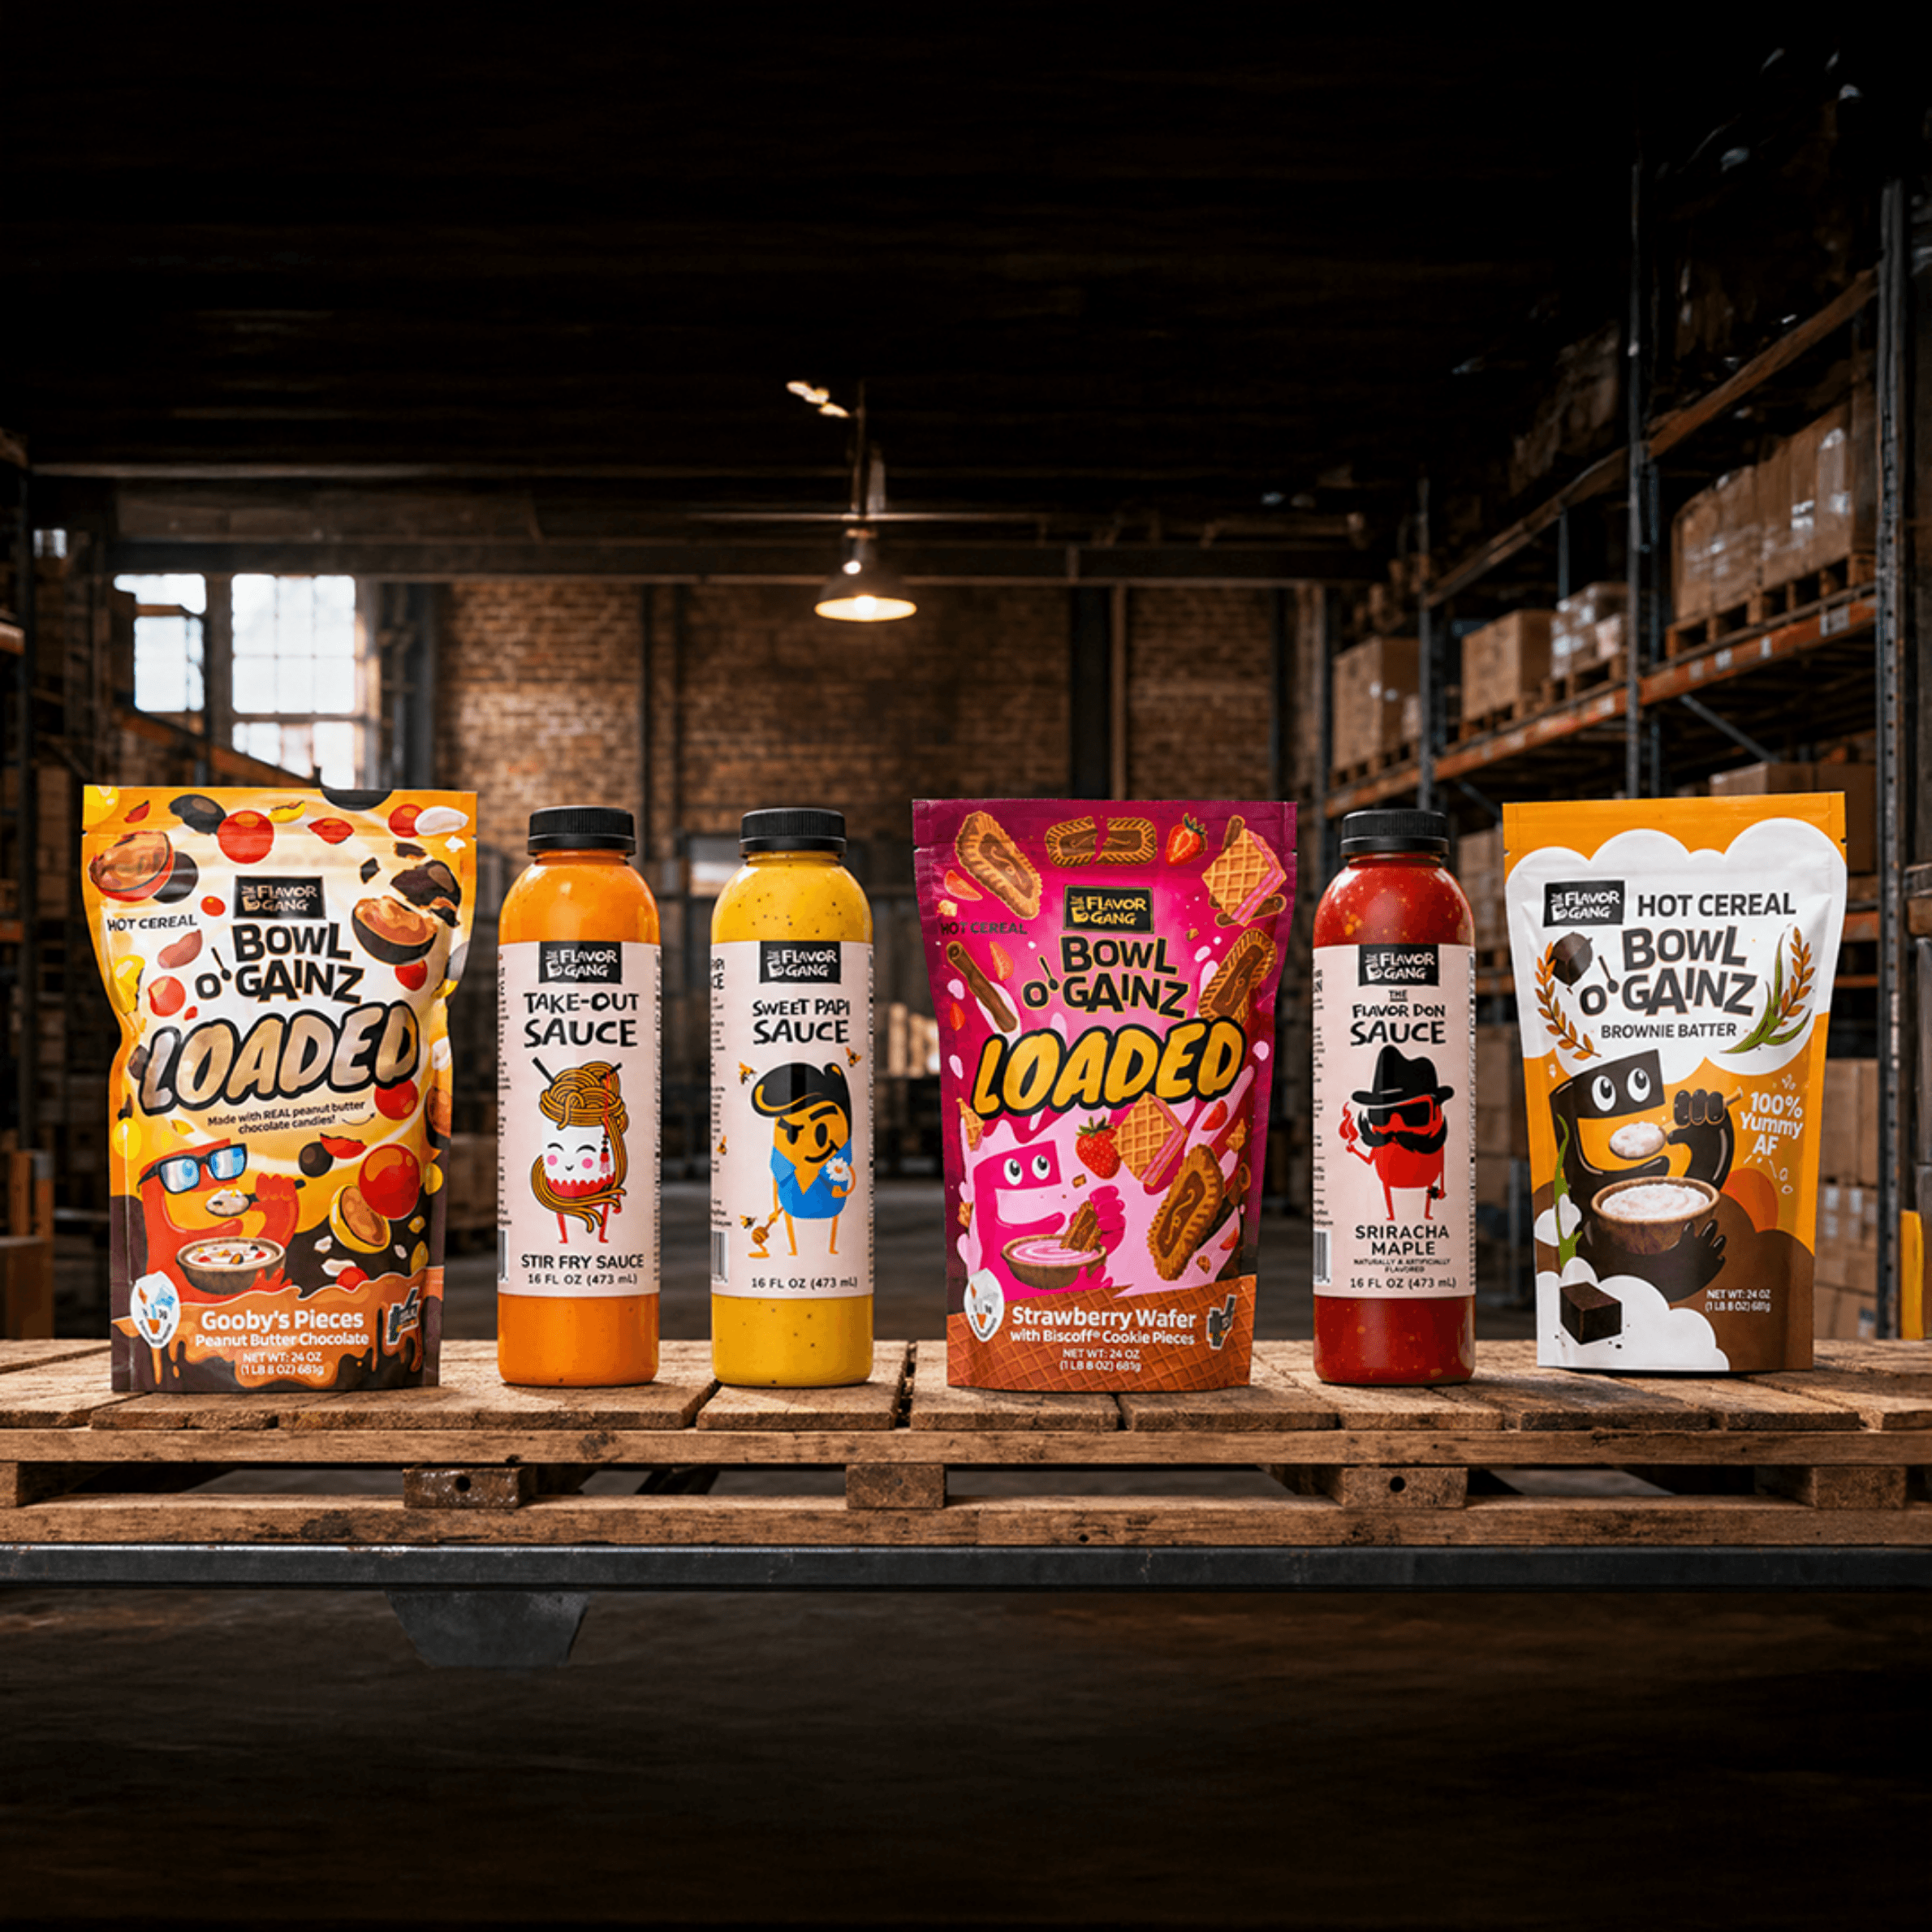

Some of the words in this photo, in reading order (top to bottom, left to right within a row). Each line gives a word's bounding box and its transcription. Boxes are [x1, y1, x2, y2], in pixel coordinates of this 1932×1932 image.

[257, 885, 317, 899] FLAVOR
[1565, 890, 1620, 906] FLAVOR
[261, 899, 309, 912] GANG
[1086, 895, 1147, 911] FLAVOR
[1637, 894, 1693, 917] HOT
[1697, 892, 1796, 917] CEREAL
[1090, 910, 1136, 925] GANG
[1568, 905, 1611, 919] GANG
[106, 918, 136, 931] HOT
[138, 914, 197, 929] CEREAL
[940, 922, 968, 935] HOT
[969, 921, 1028, 934] CEREAL
[231, 922, 352, 963] BOWL
[1621, 925, 1747, 972] BOWL
[560, 949, 618, 964] FLAVOR
[782, 950, 838, 964] FLAVOR
[1059, 935, 1179, 975] BOWL
[1380, 951, 1435, 967] FLAVOR
[564, 964, 609, 979] GANG
[785, 964, 829, 977] GANG
[1384, 967, 1426, 980] GANG
[1388, 990, 1408, 999] THE
[523, 992, 639, 1014] TAKE-OUT
[753, 998, 810, 1016] SWEET
[814, 998, 851, 1016] PAPI
[1352, 1003, 1409, 1018] FLAVOR
[1413, 1003, 1445, 1017] DON
[524, 1017, 638, 1048] SAUCE
[753, 1018, 850, 1045] SAUCE
[1350, 1020, 1446, 1046] SAUCE
[1601, 1024, 1674, 1038] BROWNIE
[1678, 1023, 1736, 1037] BATTER
[138, 1000, 420, 1116] LOADED
[971, 1016, 1247, 1119] LOADED
[1750, 1091, 1803, 1119] 100%
[207, 1115, 236, 1126] Made
[239, 1110, 261, 1123] with
[263, 1109, 291, 1119] REAL
[292, 1104, 330, 1119] peanut
[331, 1102, 365, 1112] butter
[238, 1119, 290, 1134] chocolate
[291, 1115, 335, 1128] candies!
[1740, 1110, 1804, 1140] Yummy
[1752, 1134, 1779, 1156] AF
[1356, 1225, 1450, 1240] SRIRACHA
[1372, 1241, 1435, 1256] MAPLE
[520, 1253, 554, 1269] STIR
[558, 1254, 593, 1269] FRY
[596, 1253, 645, 1269] SAUCE
[528, 1273, 541, 1284] 16
[545, 1274, 558, 1284] FL
[563, 1274, 582, 1284] OZ
[587, 1273, 614, 1287] (473
[752, 1278, 765, 1288] 16
[770, 1278, 784, 1288] FL
[788, 1277, 806, 1288] OZ
[810, 1277, 837, 1290] (473
[1350, 1277, 1365, 1288] 16
[1368, 1278, 1382, 1288] FL
[1386, 1278, 1404, 1288] OZ
[1408, 1278, 1434, 1290] (473
[1706, 1289, 1726, 1299] NET
[1758, 1289, 1770, 1299] OZ
[201, 1309, 291, 1334] Gooby's
[294, 1309, 364, 1329] Pieces
[1011, 1306, 1133, 1331] Strawberry
[1135, 1309, 1197, 1328] Wafer
[195, 1334, 248, 1347] Peanut
[249, 1334, 300, 1347] Butter
[300, 1331, 369, 1346] Chocolate
[1010, 1328, 1041, 1342] with
[1102, 1330, 1150, 1343] Cookie
[1152, 1330, 1196, 1345] Pieces
[243, 1352, 266, 1363] NET
[291, 1352, 305, 1362] 24
[306, 1352, 322, 1362] OZ
[1062, 1348, 1085, 1359] NET
[1110, 1348, 1123, 1359] 24
[1124, 1349, 1141, 1359] OZ
[251, 1365, 265, 1374] LB
[276, 1365, 295, 1375] OZ)
[1070, 1361, 1084, 1370] LB
[1094, 1361, 1114, 1372] OZ)
